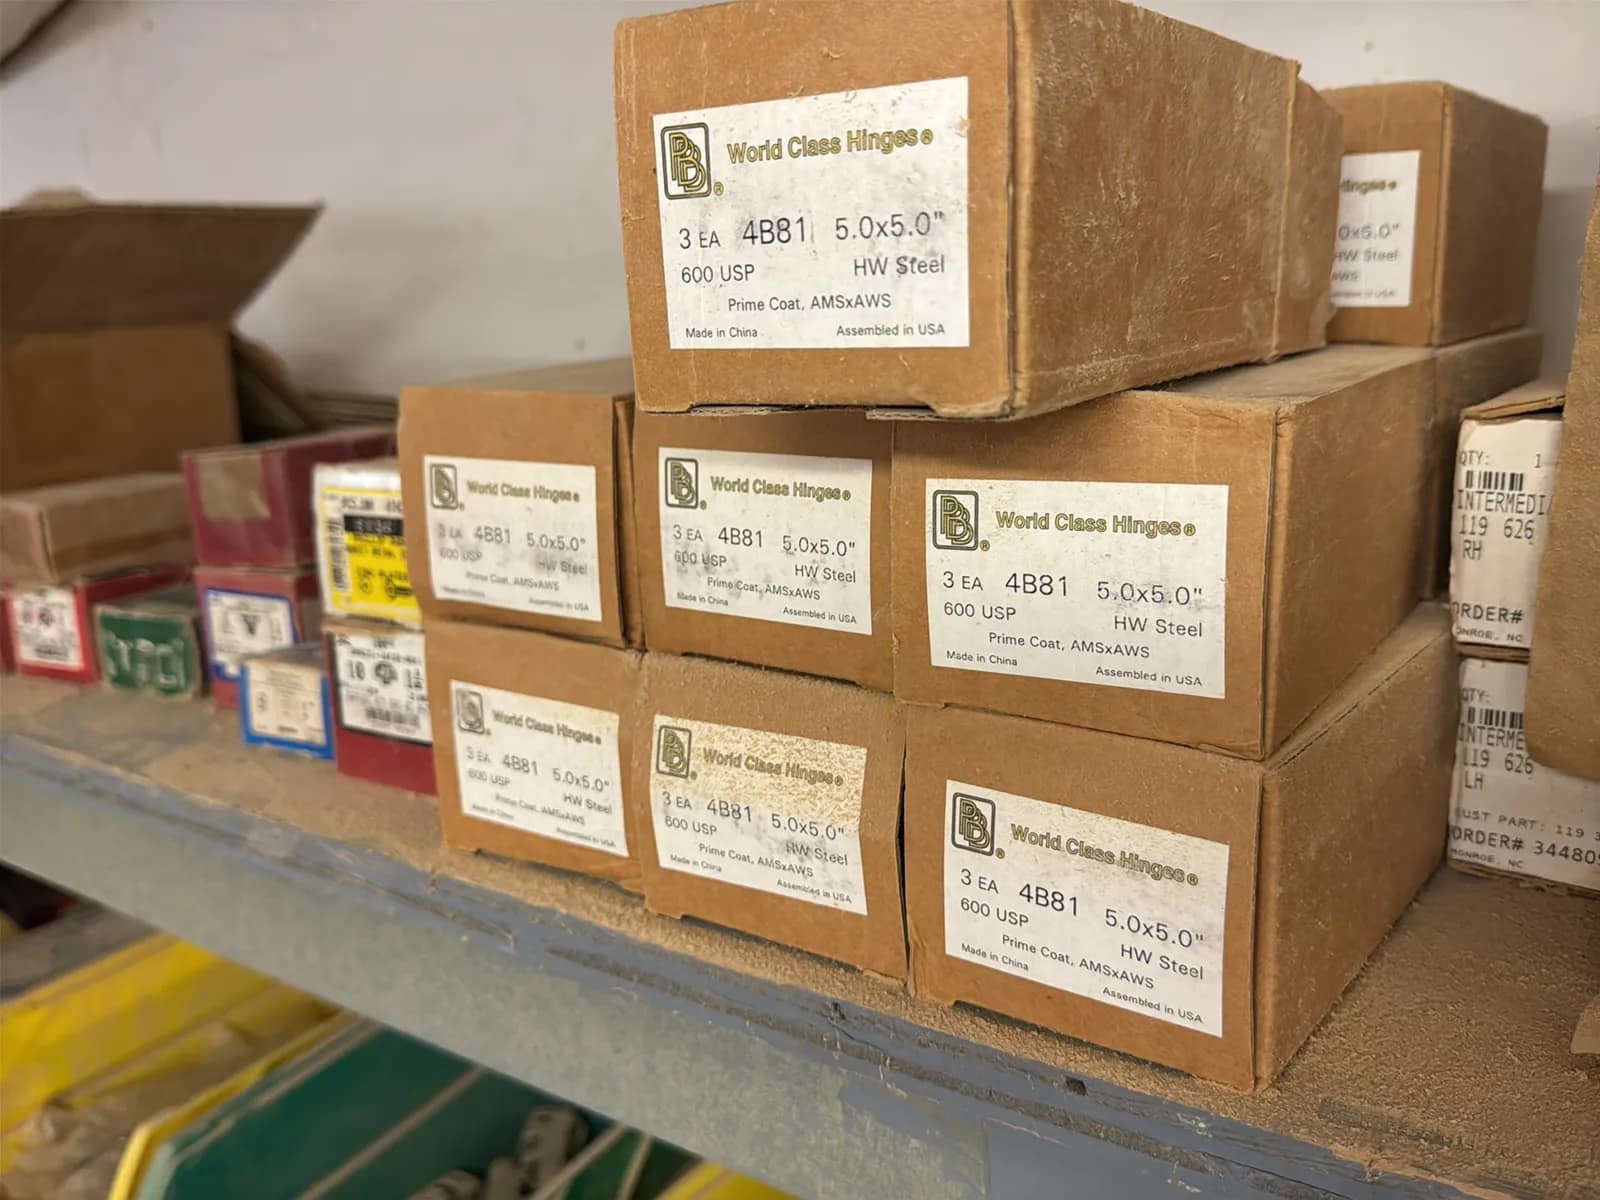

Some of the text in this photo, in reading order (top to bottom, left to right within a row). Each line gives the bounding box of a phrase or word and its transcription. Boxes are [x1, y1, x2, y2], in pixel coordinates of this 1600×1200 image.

[727, 139, 782, 164] World
[788, 133, 841, 158] Class
[680, 211, 944, 249] 3 EA 4B81 5.0x5.0"
[681, 265, 755, 283] 600 USP
[854, 256, 944, 276] HW Steel
[728, 294, 891, 312] Prime Coat, AMSxAWS
[686, 327, 758, 338] Made in China
[837, 324, 945, 337] Assembled in USA
[1459, 450, 1542, 468] QTY: 1
[467, 480, 498, 495] World
[710, 476, 749, 493] World
[752, 479, 789, 496] Class
[996, 511, 1049, 530] World
[1055, 513, 1106, 532] Class
[1459, 514, 1534, 539] 119 626
[475, 525, 511, 544] 4B81
[527, 532, 586, 551] 5.0x5.0"
[673, 524, 855, 557] 3 EA 4B81 5.0x5.0"
[702, 554, 727, 567] USP
[1463, 539, 1482, 560] RH
[795, 565, 856, 583] HW Steel
[677, 592, 696, 601] Made
[708, 596, 728, 606] China
[707, 577, 733, 589] Prime
[765, 584, 820, 600] AMSxAWS
[944, 571, 1202, 605] 3 EA 4B81 5.0x5.0"
[783, 606, 856, 624] Assembled in USA
[944, 603, 1016, 620] 600 USP
[1114, 616, 1202, 637] HW Steel
[1507, 628, 1523, 643] NC
[989, 633, 1150, 659] Prime Coat, AMSxAWS
[947, 651, 1017, 666] Made in China
[1096, 667, 1202, 687] Assembled in USA
[703, 748, 742, 768] World
[744, 755, 782, 776] Class
[1505, 754, 1533, 774] 626
[502, 754, 538, 776] 4B81
[553, 768, 610, 793] 5.0x5.0"
[1465, 774, 1483, 790] LH
[663, 791, 844, 841] 3 EA 4B81 5.0x5.0"
[665, 815, 717, 836] 600 USP
[1499, 815, 1544, 831] PART:
[1557, 824, 1584, 839] 119
[1011, 823, 1061, 850] World
[1066, 838, 1115, 865] Class
[1452, 825, 1523, 851] ORDER#
[699, 843, 725, 857] Prime
[758, 856, 813, 877] AMSxAWS
[785, 841, 848, 866] HW Steel
[1508, 859, 1523, 869] NC
[777, 879, 820, 897] Assembled
[833, 892, 852, 904] USA
[961, 868, 1204, 948] 3 EA 4B81 5.0x5.0"
[961, 898, 1029, 928] 600 USP
[961, 943, 1029, 971] Made in China
[1002, 934, 1154, 990] Prime Coat, AMSxAWS
[1121, 943, 1204, 980] HW Steel
[1103, 986, 1203, 1024] Assembled in USA
